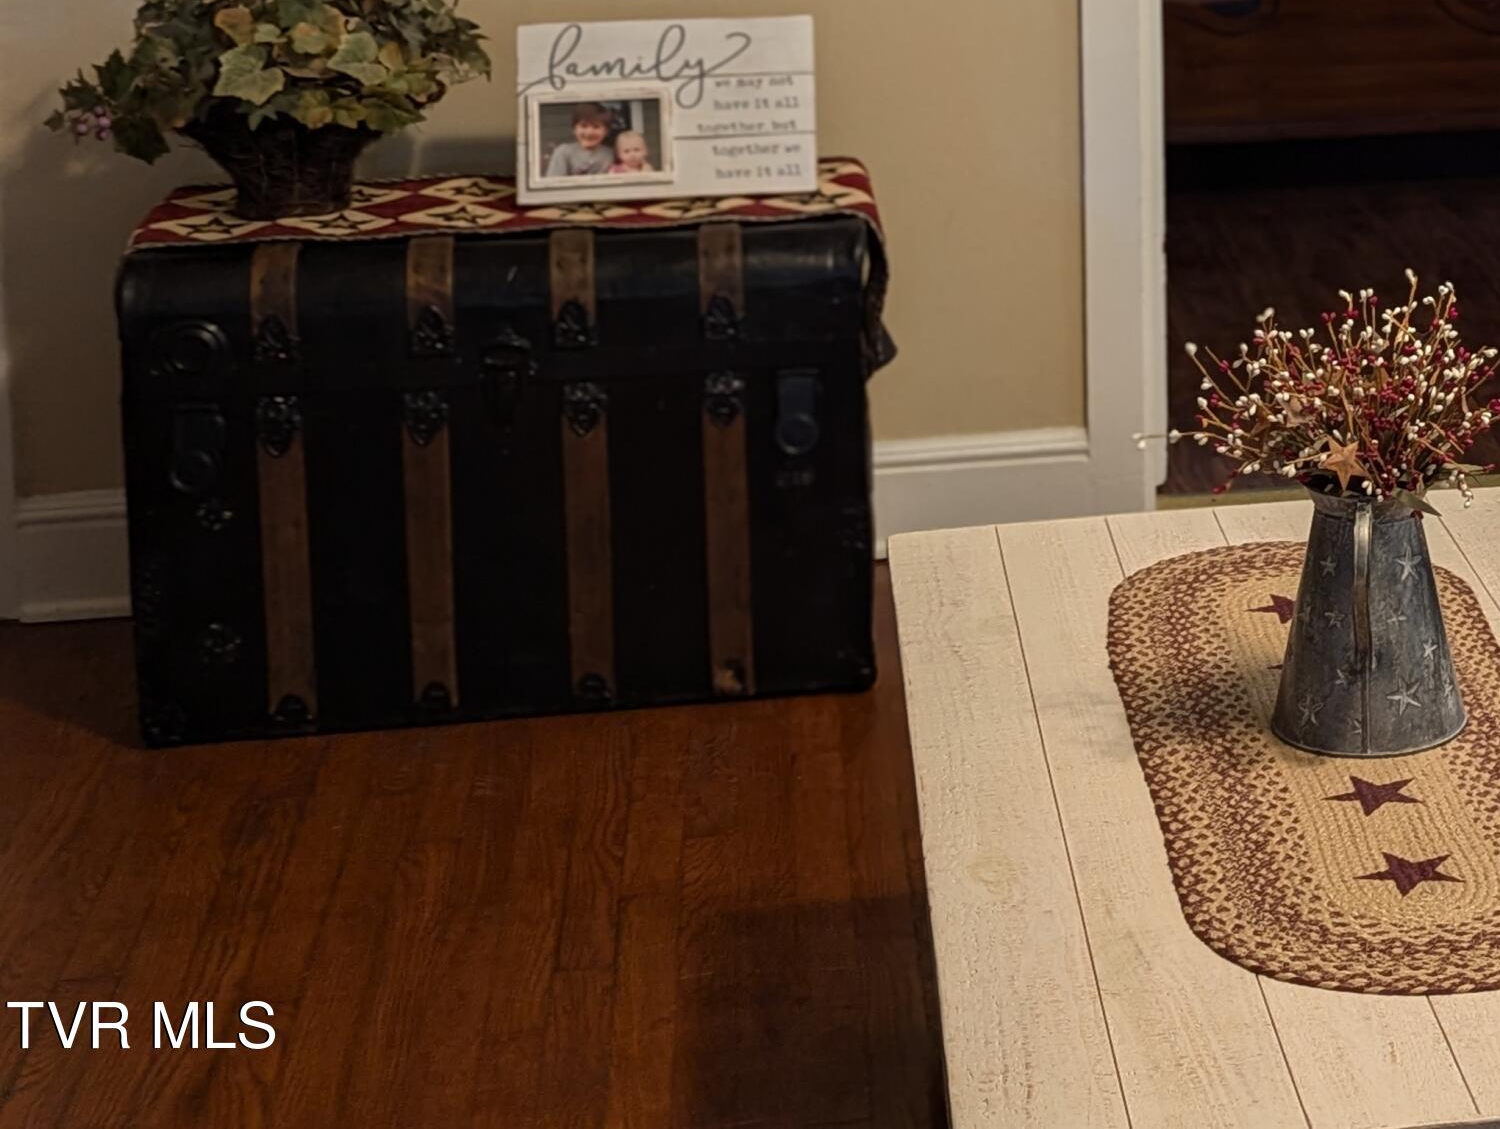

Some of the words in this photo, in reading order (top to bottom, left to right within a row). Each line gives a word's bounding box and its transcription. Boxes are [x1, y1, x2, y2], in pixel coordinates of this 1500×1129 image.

[518, 23, 751, 109] family
[713, 98, 750, 110] have
[755, 97, 769, 109] it
[775, 96, 799, 108] all
[771, 118, 796, 130] but
[712, 143, 779, 158] together
[784, 144, 801, 153] we
[715, 168, 752, 179] have
[757, 166, 772, 178] it
[777, 164, 801, 177] all
